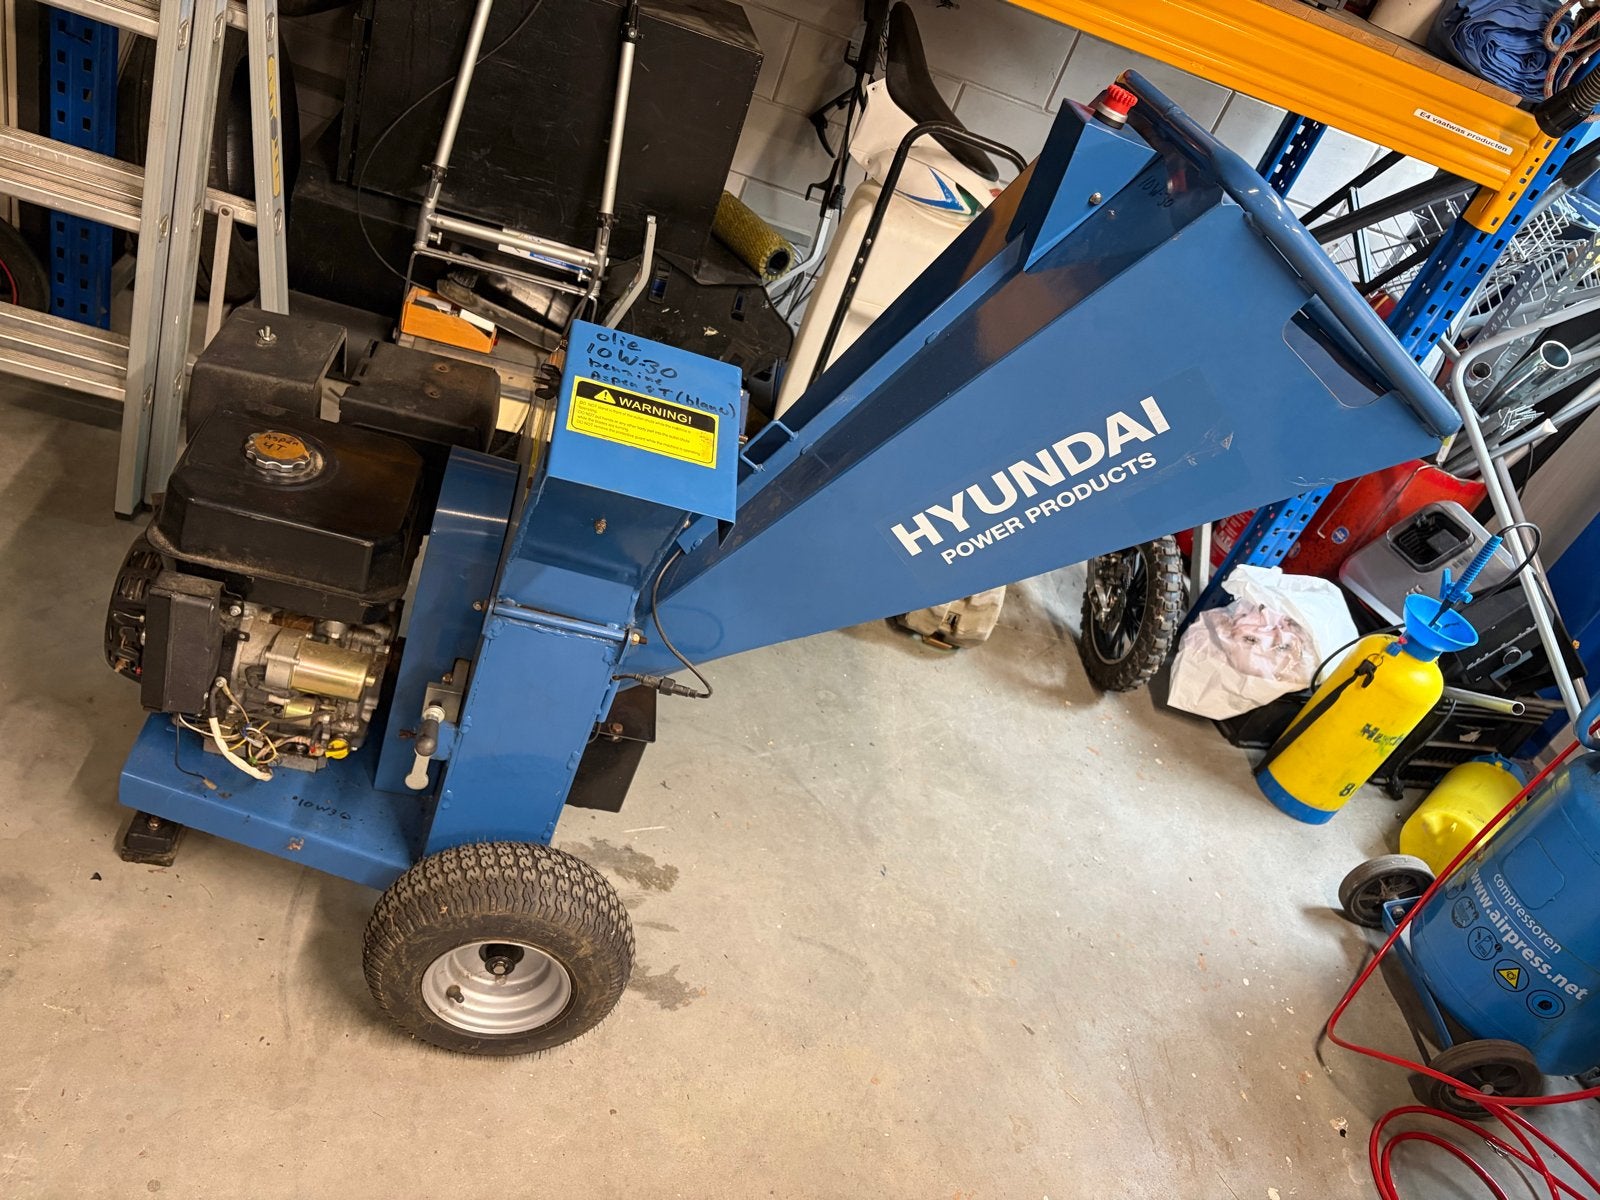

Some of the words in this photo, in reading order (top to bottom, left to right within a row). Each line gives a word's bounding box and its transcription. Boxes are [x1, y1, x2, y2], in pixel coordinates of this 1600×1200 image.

[1419, 111, 1431, 120] E4
[1432, 117, 1466, 135] vaatwas
[596, 332, 642, 352] olie
[619, 396, 692, 425] WARNING!
[890, 396, 1171, 557] HYUNDAI
[940, 517, 1024, 565] POWER
[1025, 452, 1157, 526] PRODUCTS
[1470, 868, 1589, 1000] www.airpress.net
[1493, 873, 1562, 955] compressoren
